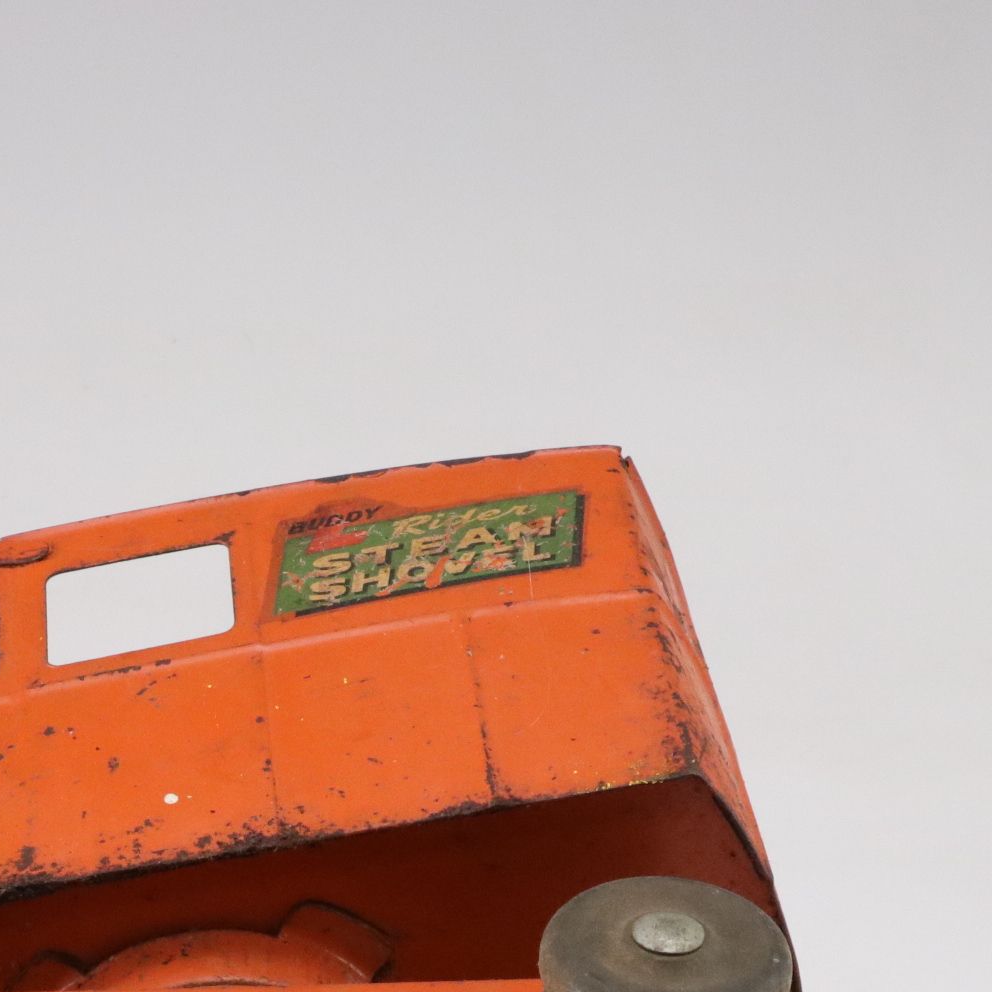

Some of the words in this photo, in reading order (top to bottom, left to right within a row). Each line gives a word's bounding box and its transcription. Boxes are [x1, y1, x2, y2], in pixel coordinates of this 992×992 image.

[287, 504, 384, 535] BUDDY
[390, 504, 537, 540] Rider
[313, 515, 553, 578] STEAM
